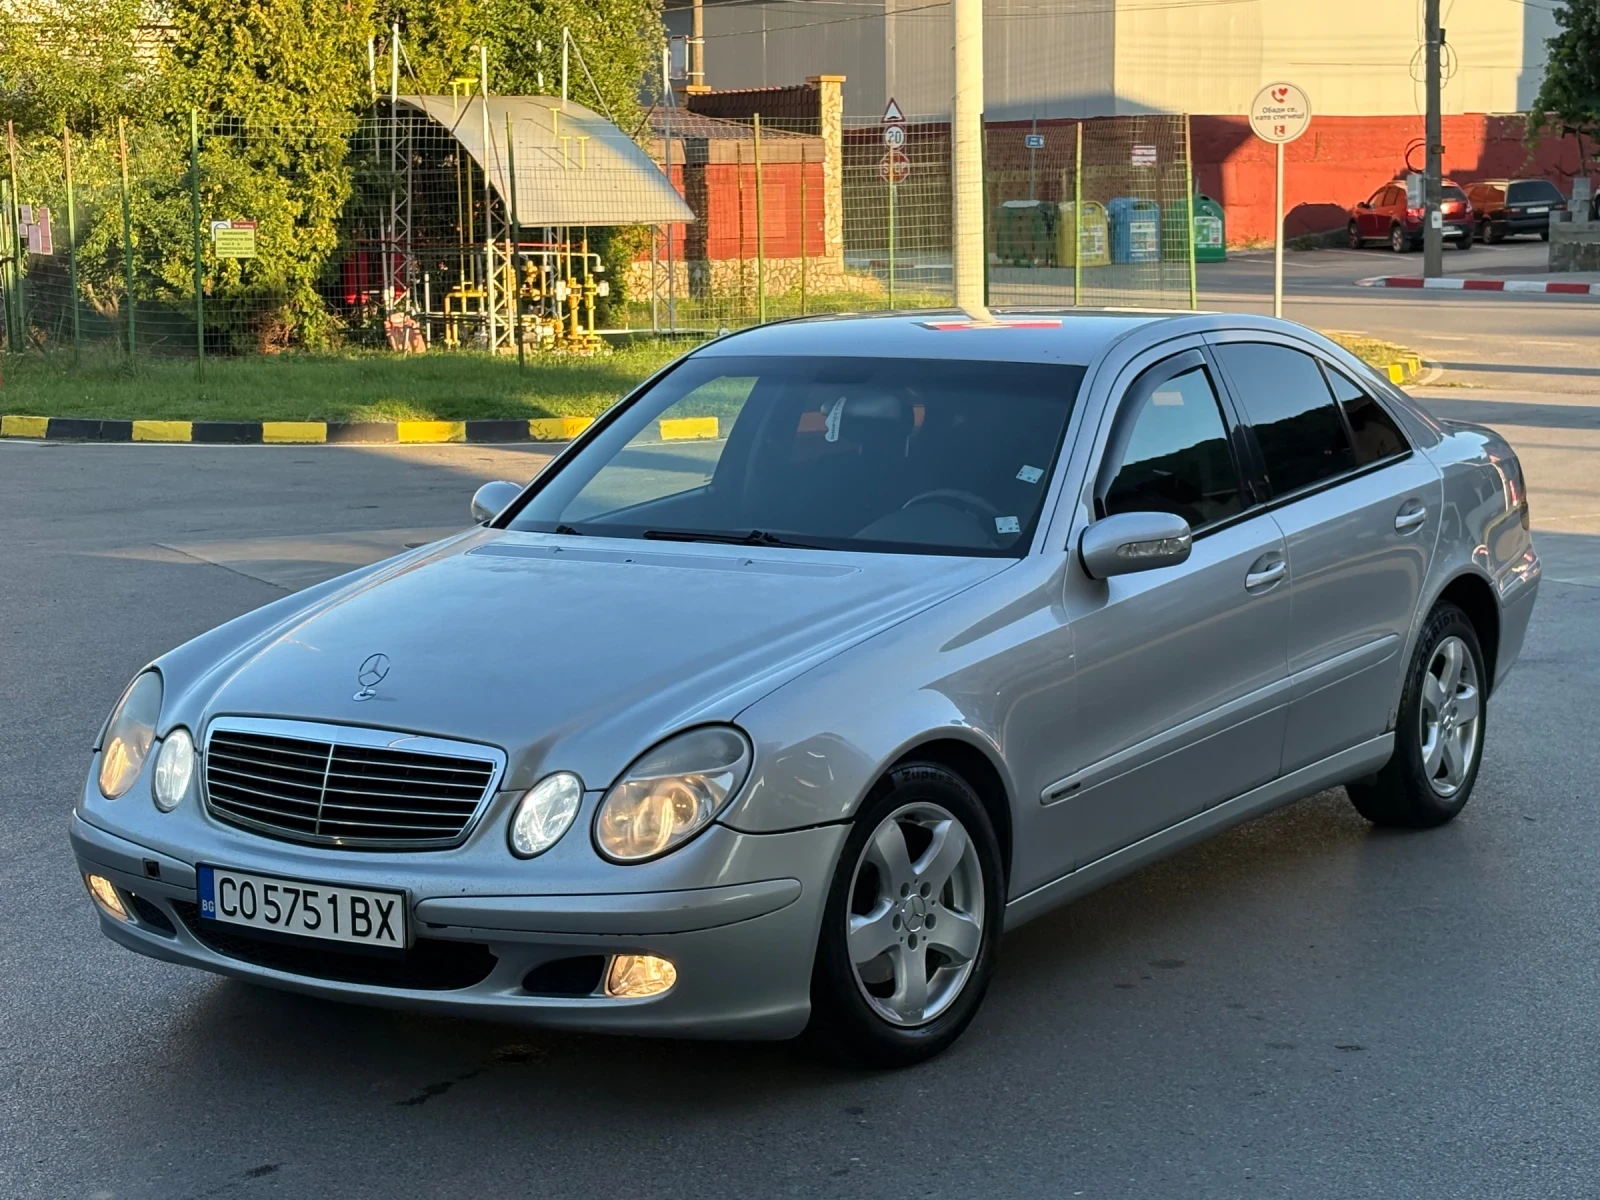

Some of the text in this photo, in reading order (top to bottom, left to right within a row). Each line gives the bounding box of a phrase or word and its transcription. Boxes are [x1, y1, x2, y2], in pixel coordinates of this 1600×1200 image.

[1273, 112, 1305, 121] стигнеш!
[888, 130, 902, 144] 20
[201, 899, 215, 913] BG
